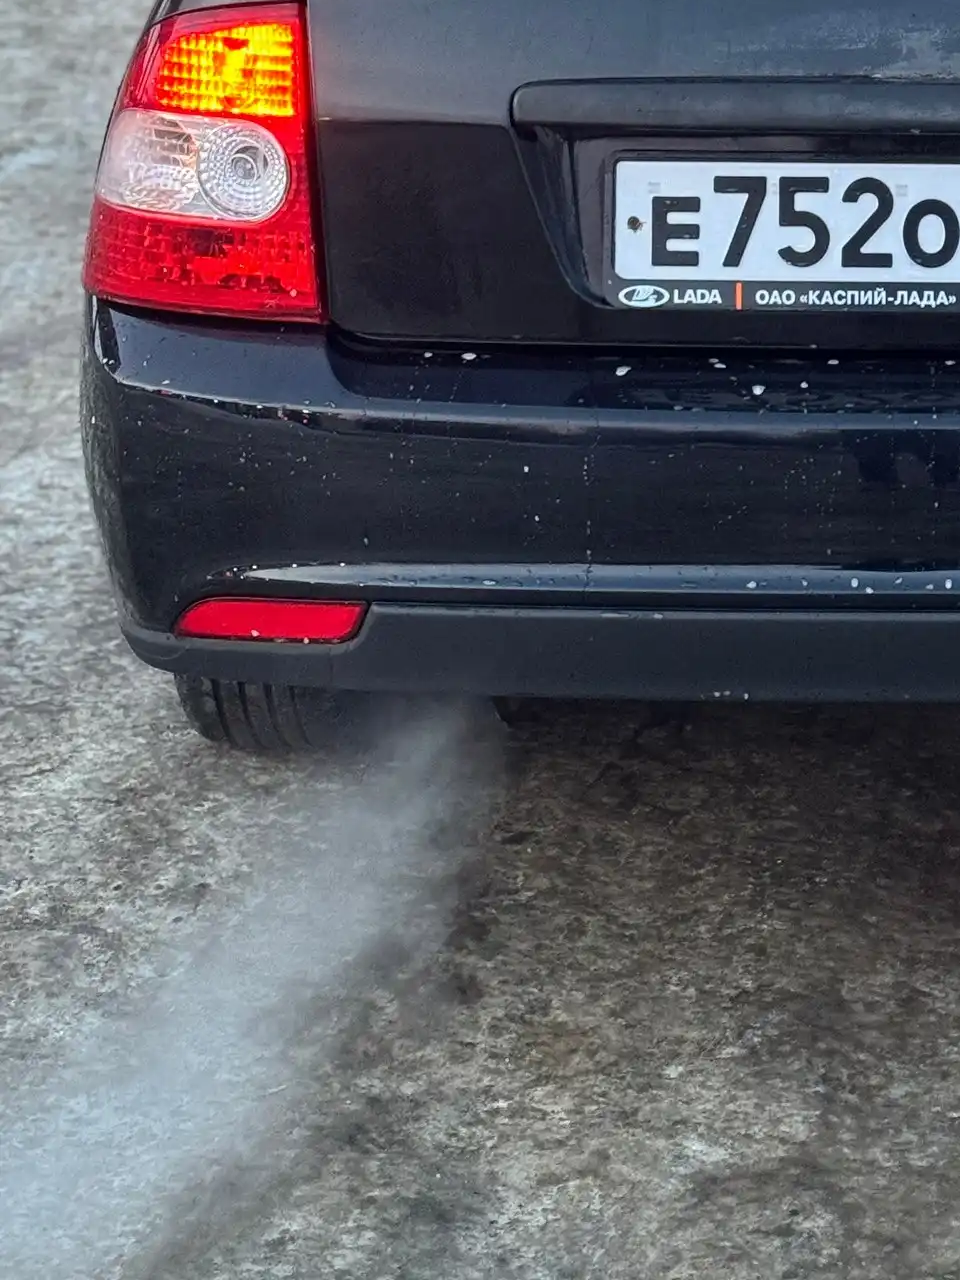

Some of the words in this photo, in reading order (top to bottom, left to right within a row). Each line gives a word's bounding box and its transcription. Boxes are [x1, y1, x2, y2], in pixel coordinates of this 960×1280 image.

[673, 288, 723, 304] LADA
[755, 289, 796, 306] ОАО
[800, 287, 957, 308] «КАСПИЙ-ЛАДА»
